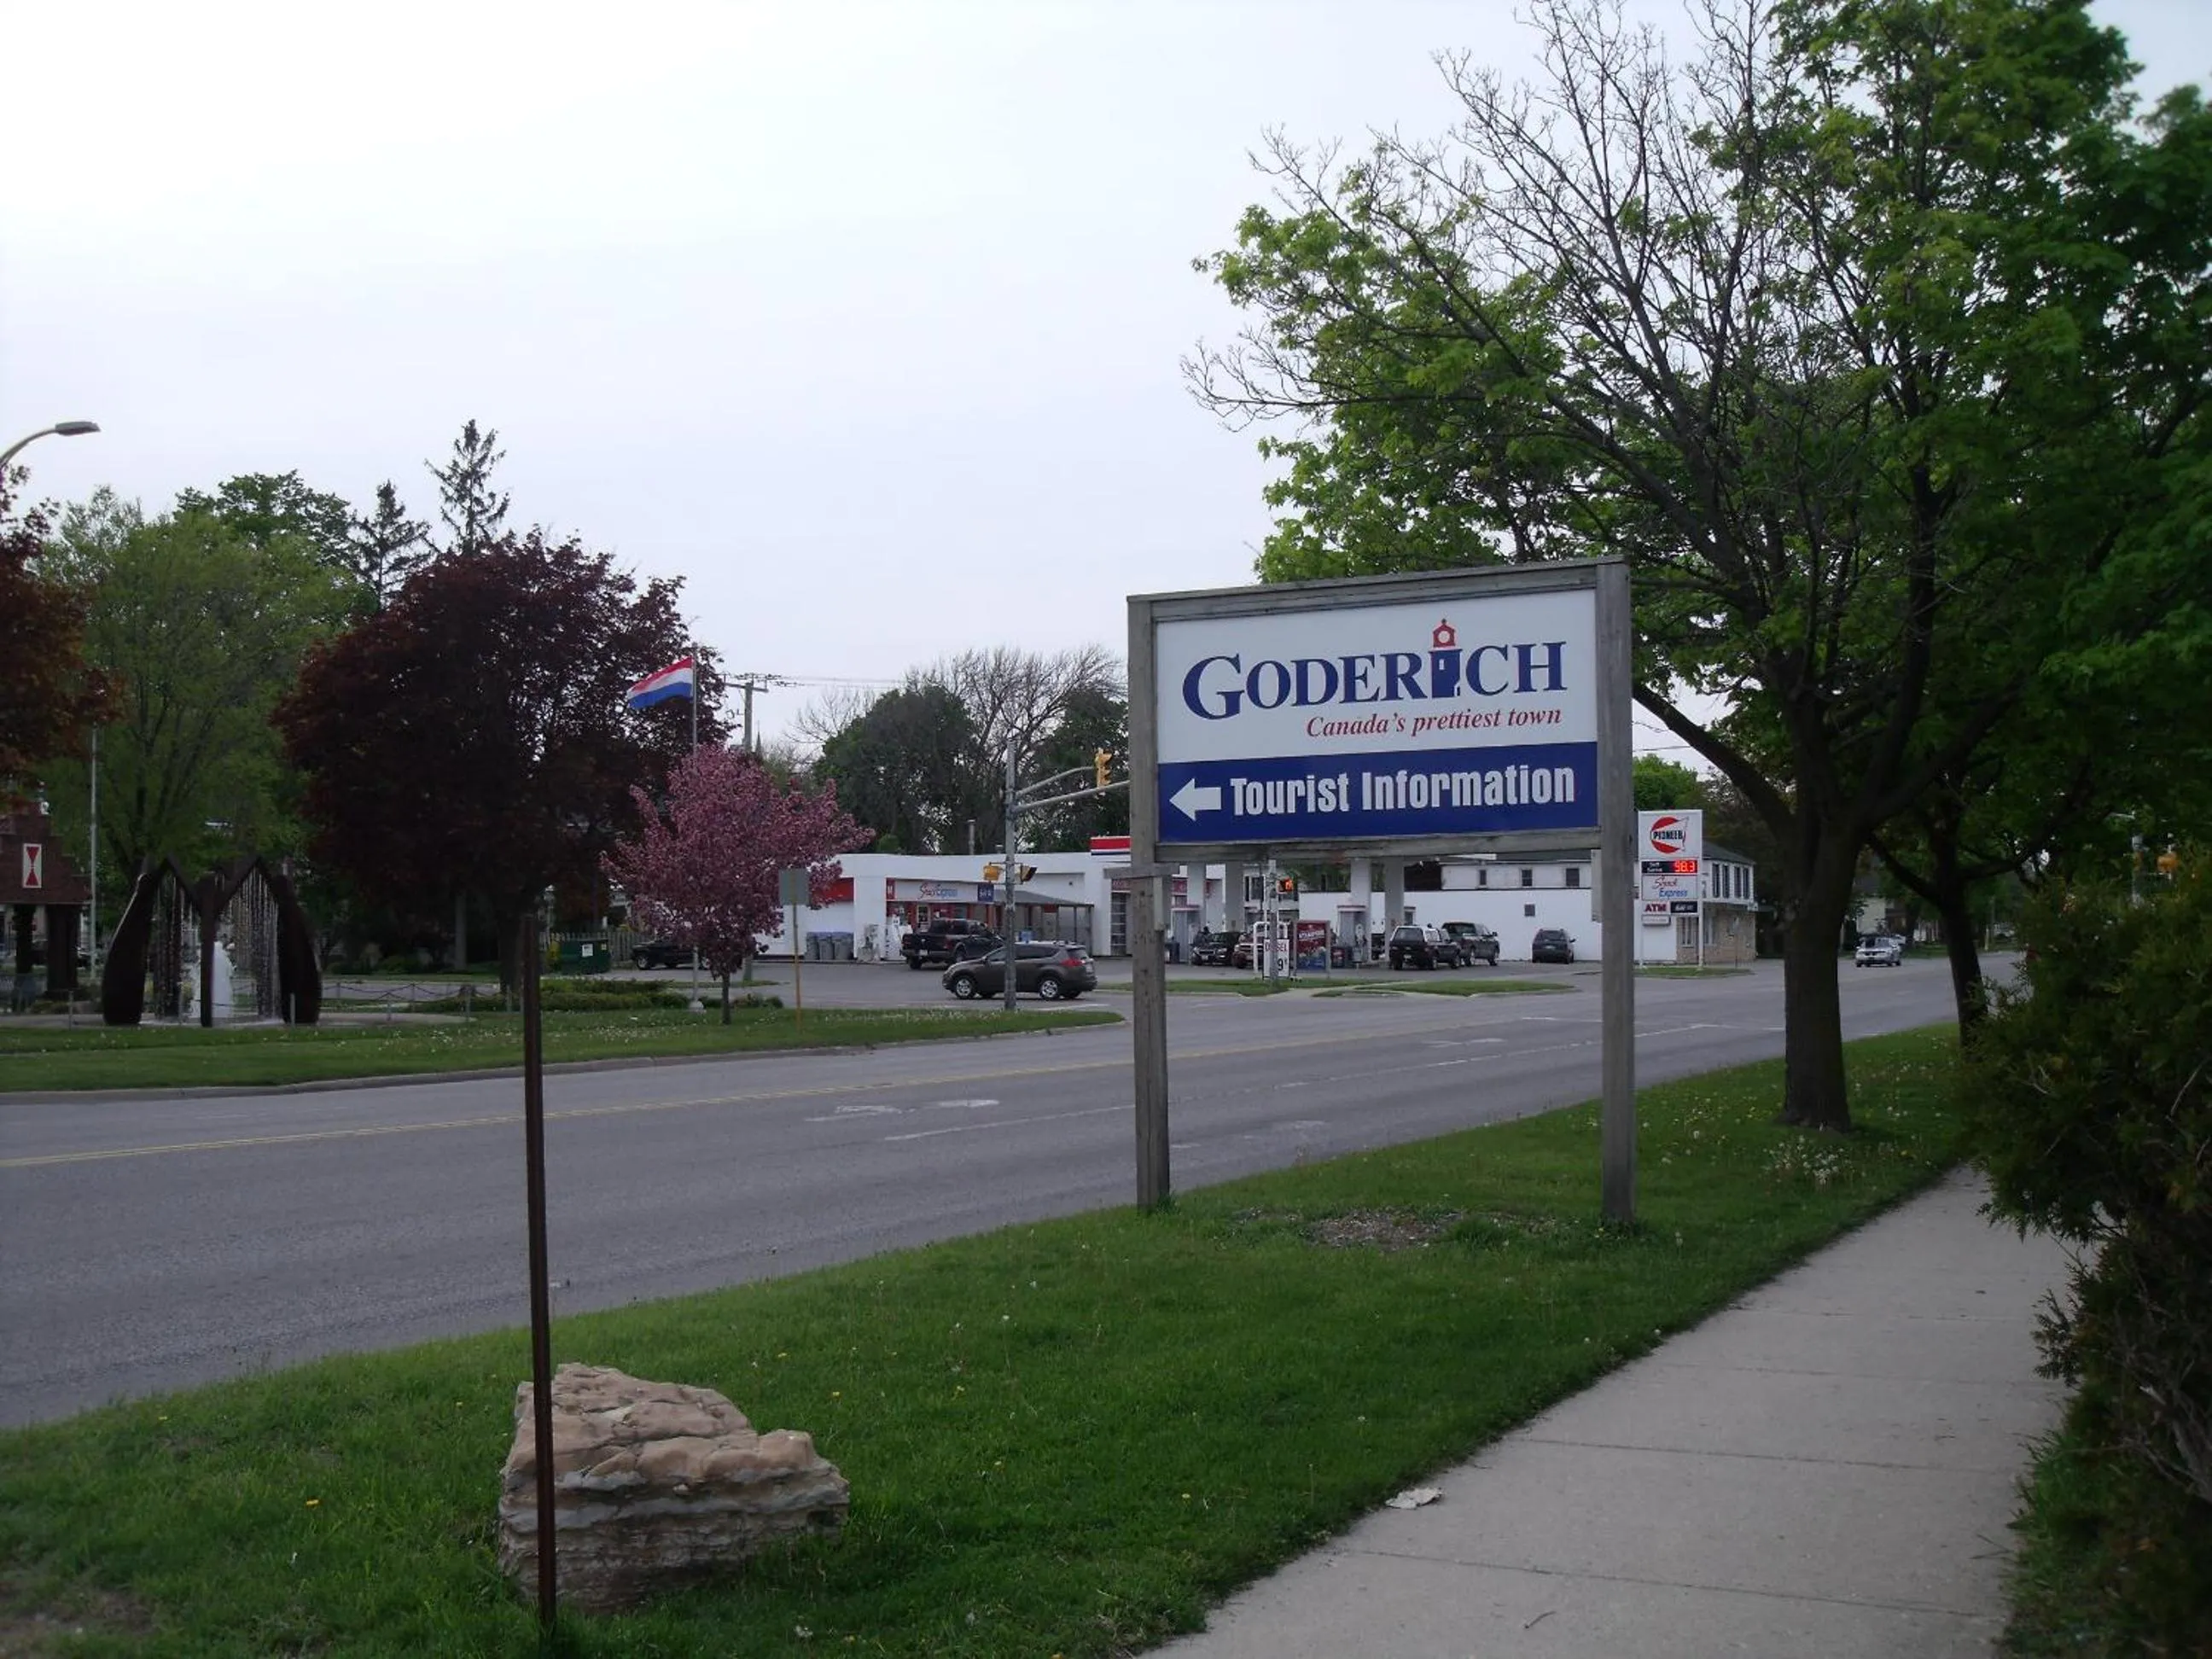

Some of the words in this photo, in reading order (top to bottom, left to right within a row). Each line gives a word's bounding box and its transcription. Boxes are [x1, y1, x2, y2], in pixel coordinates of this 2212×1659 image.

[1182, 640, 1568, 720] GODERICH
[1306, 712, 1406, 738] Canada's
[1412, 709, 1501, 737] prettiest
[1507, 707, 1562, 726] town
[1230, 771, 1350, 817] Tourist
[1362, 764, 1575, 811] Information
[1644, 903, 1667, 912] ATM
